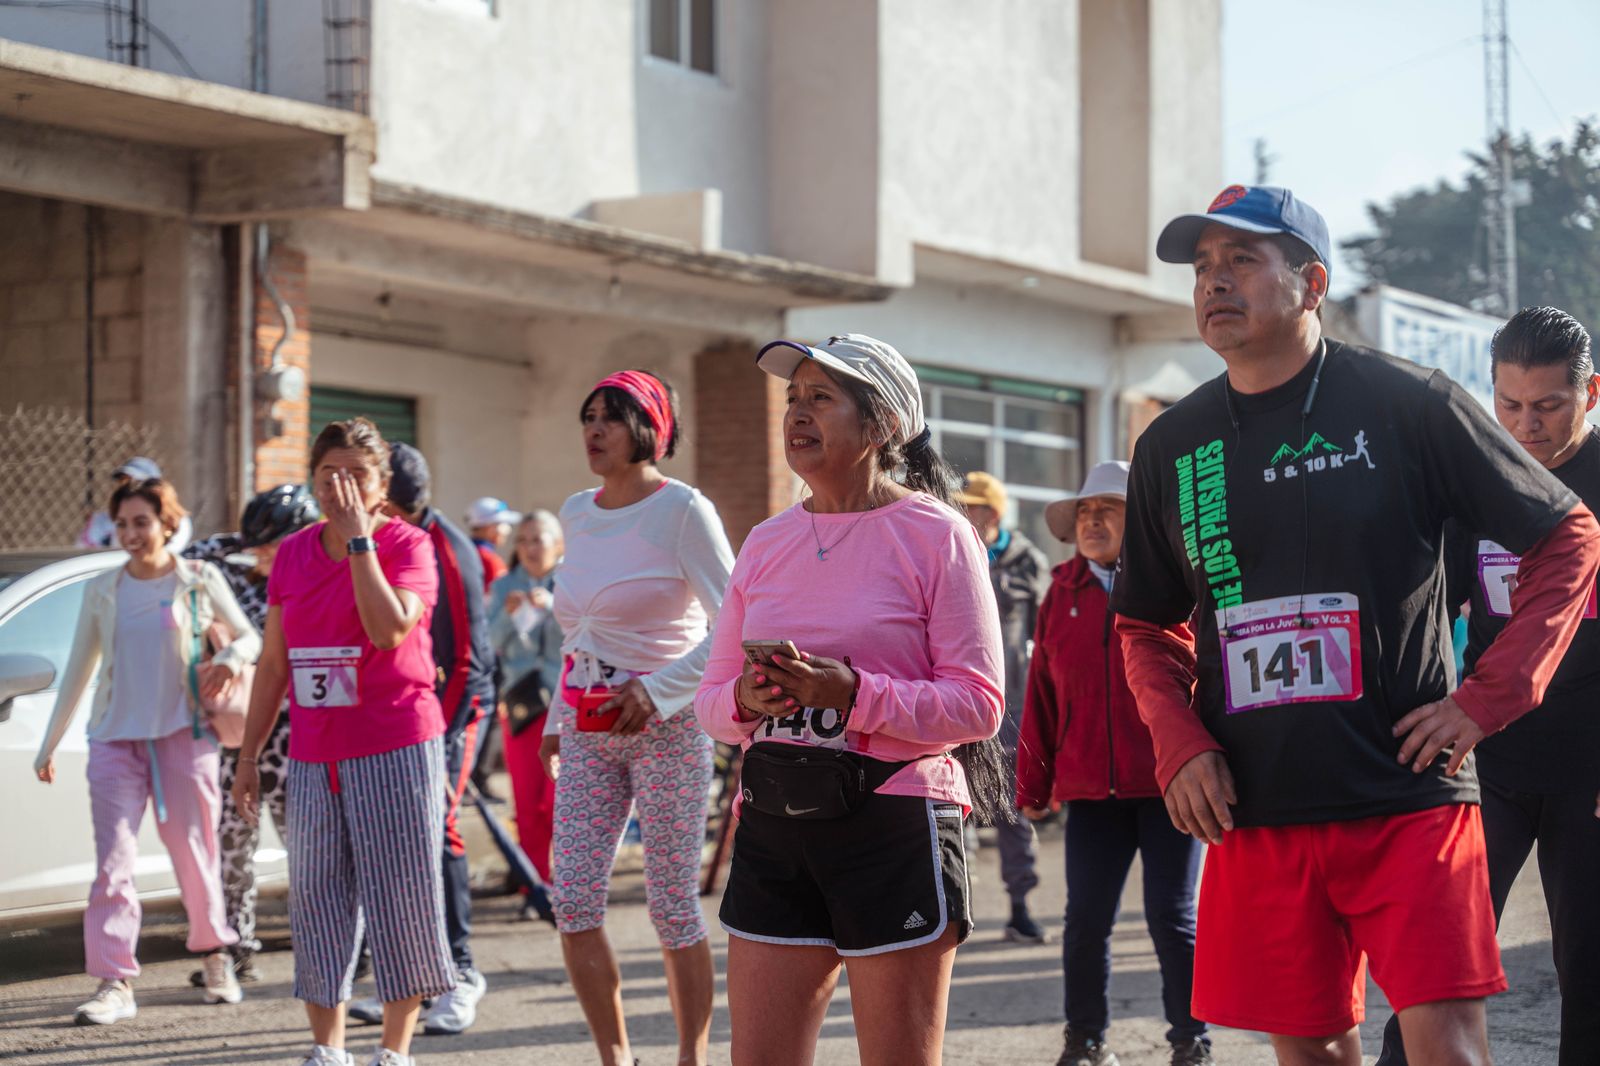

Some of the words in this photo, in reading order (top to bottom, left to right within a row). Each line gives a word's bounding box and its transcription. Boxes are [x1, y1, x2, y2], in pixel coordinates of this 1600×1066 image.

[1175, 453, 1195, 525] RUNNING
[1195, 439, 1229, 540] PAISAJES
[1263, 467, 1276, 482] 5
[1284, 465, 1298, 478] &
[1304, 456, 1326, 473] 10
[1330, 453, 1343, 468] K
[1182, 522, 1200, 570] TRAIL
[1201, 538, 1241, 585] LOS
[1265, 621, 1275, 631] LA
[312, 674, 327, 700] 3
[1243, 639, 1324, 693] 141
[903, 920, 928, 930] adidas
